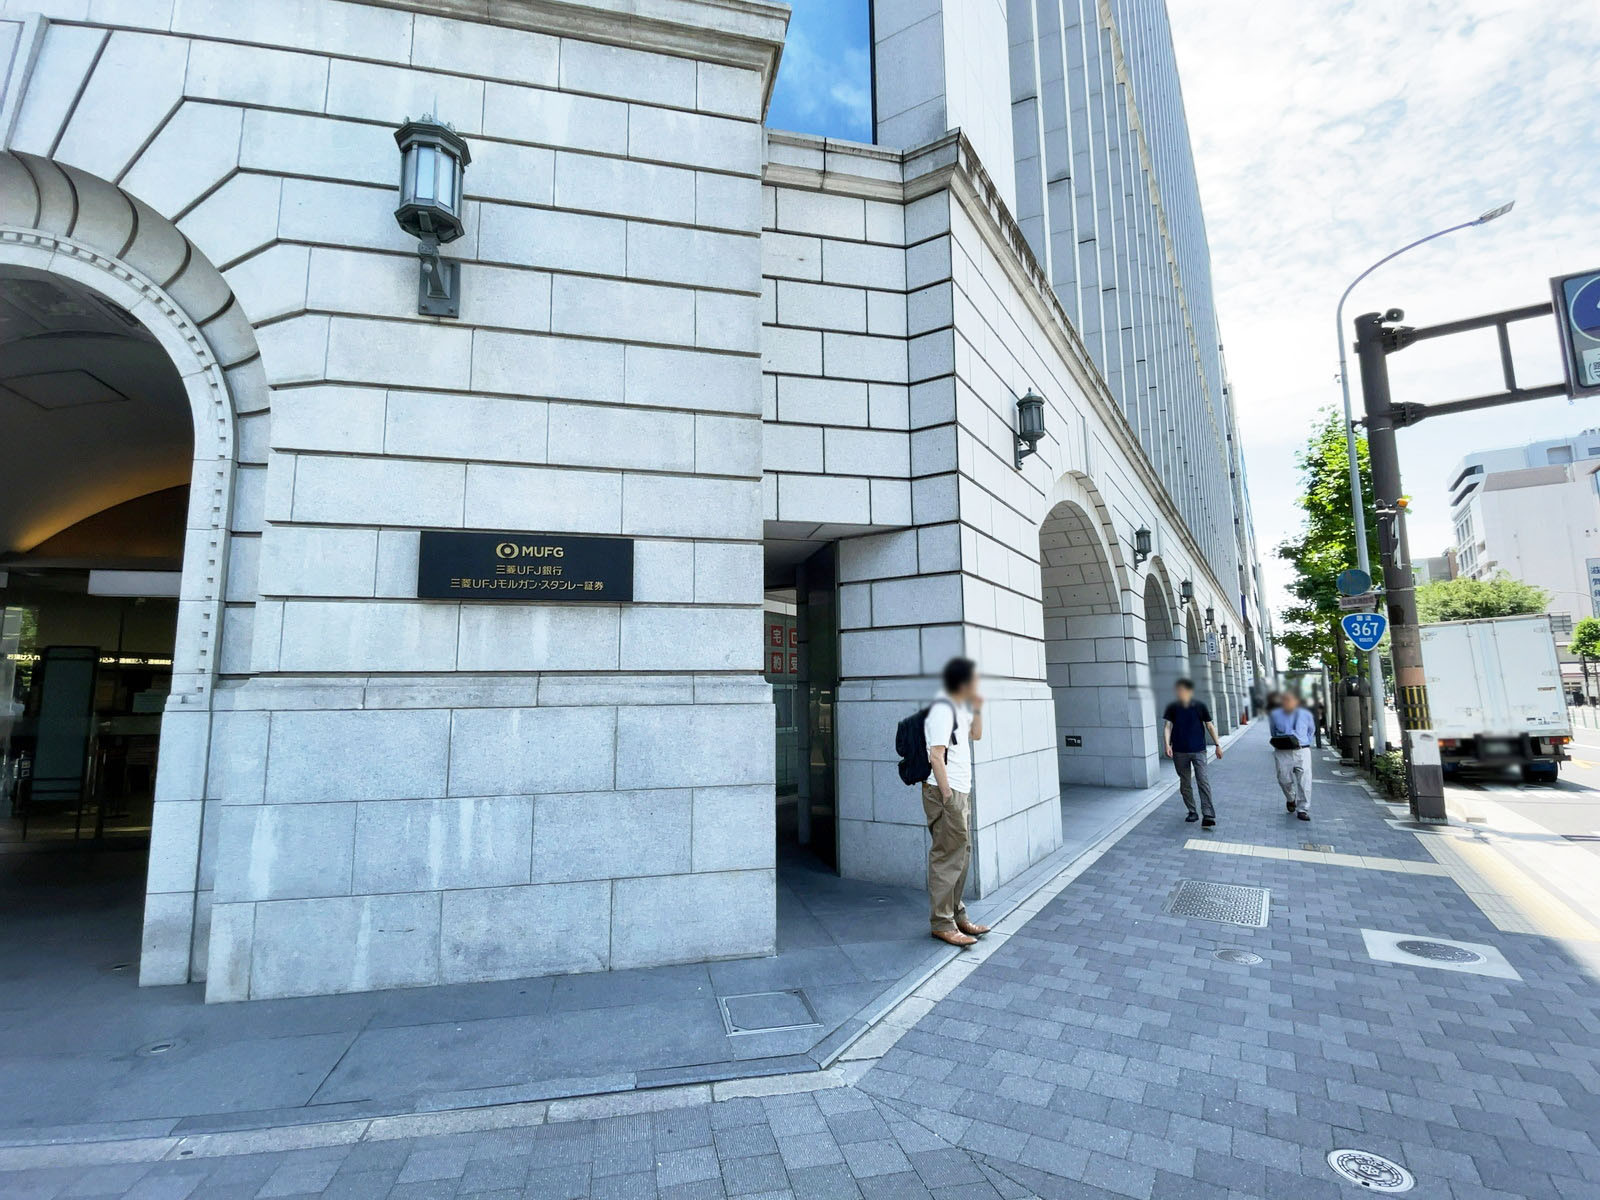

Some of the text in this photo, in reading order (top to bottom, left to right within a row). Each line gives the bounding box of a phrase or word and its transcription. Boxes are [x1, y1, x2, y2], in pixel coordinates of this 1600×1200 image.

[522, 546, 564, 558] MUFG
[496, 564, 562, 576] 三菱UFJ銀行
[1351, 622, 1379, 637] 367
